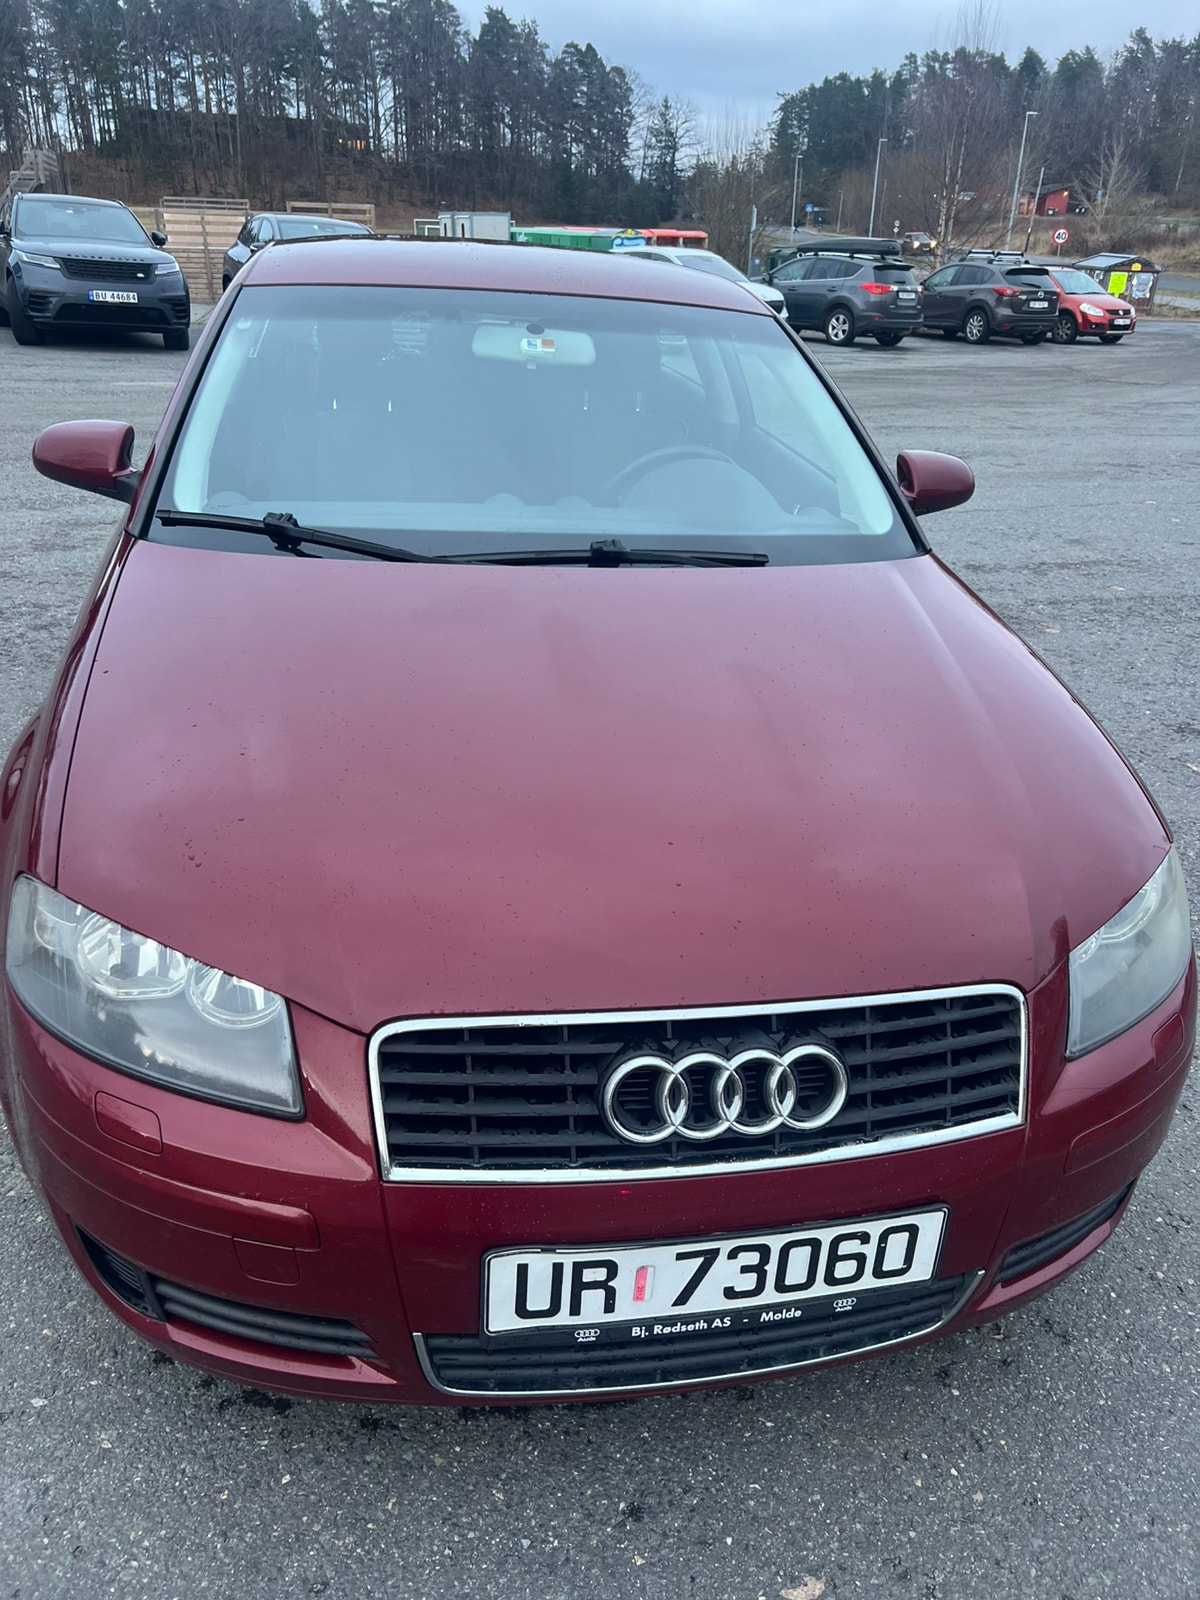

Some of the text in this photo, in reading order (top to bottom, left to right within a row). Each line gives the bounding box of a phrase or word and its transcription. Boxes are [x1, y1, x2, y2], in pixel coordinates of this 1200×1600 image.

[1055, 231, 1067, 240] 40
[95, 292, 136, 301] BU 44684
[515, 1223, 919, 1319] UR 73060
[631, 1327, 649, 1337] Bj.
[653, 1320, 707, 1335] Rødseth
[711, 1317, 731, 1328] AS
[760, 1308, 802, 1322] Molde
